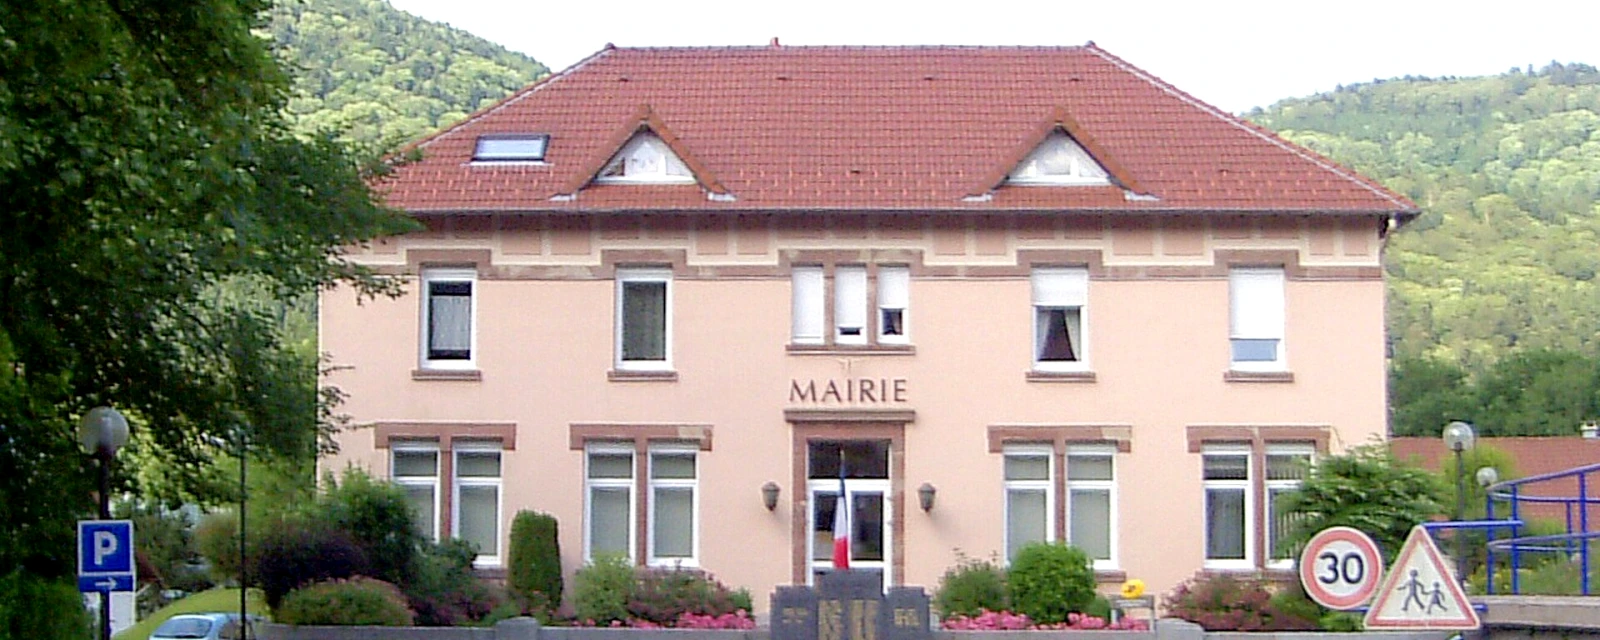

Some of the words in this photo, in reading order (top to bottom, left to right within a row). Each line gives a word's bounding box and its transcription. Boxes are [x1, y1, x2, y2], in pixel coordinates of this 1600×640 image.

[789, 379, 908, 402] MAIRIE
[93, 531, 118, 566] P
[1318, 551, 1364, 584] 30
